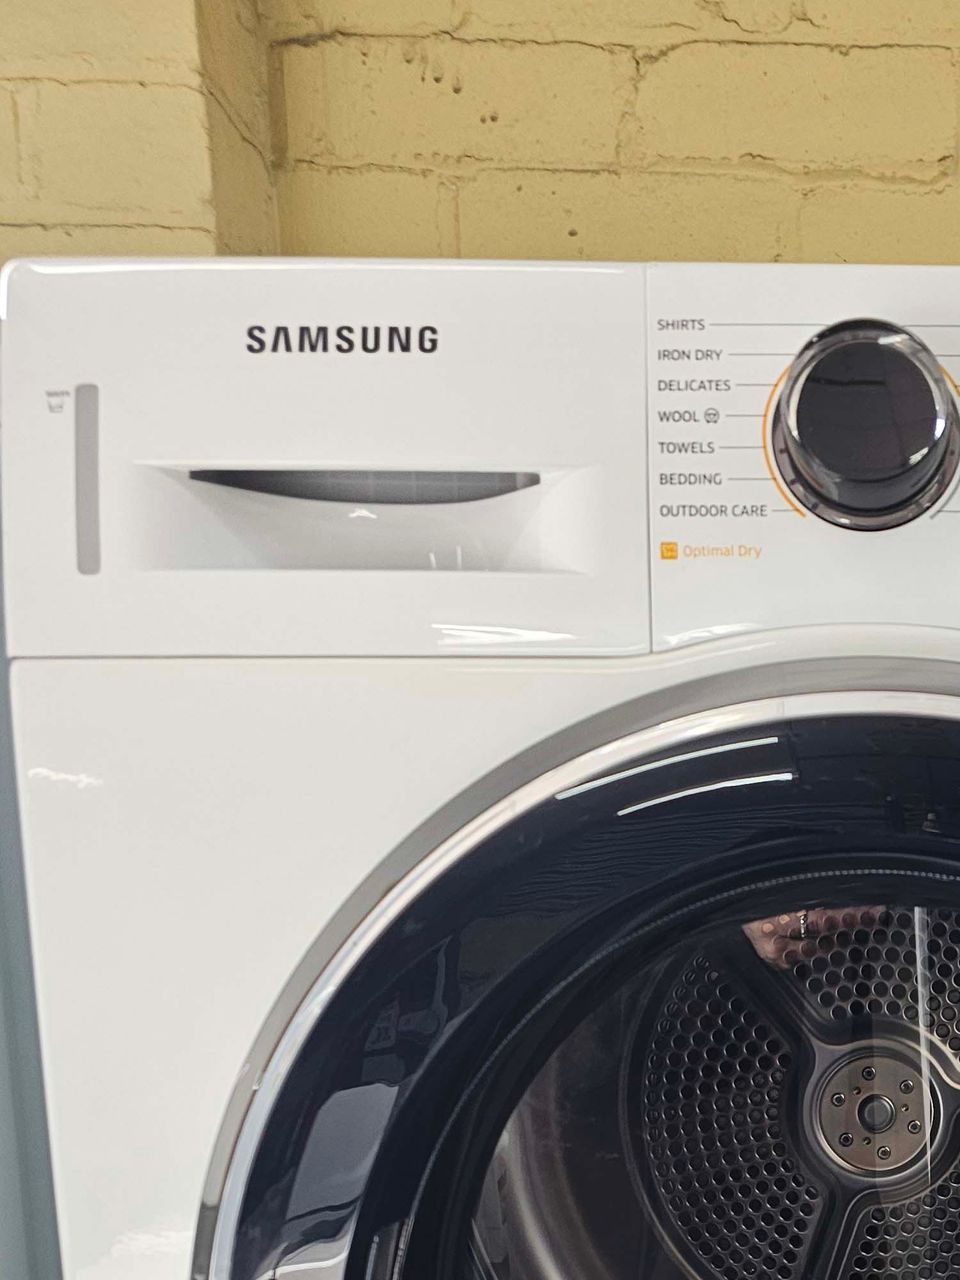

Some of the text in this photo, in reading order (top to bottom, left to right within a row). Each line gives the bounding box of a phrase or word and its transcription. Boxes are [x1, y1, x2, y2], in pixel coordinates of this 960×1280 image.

[657, 319, 706, 331] SHIRTS
[246, 325, 440, 354] SAMSUNG
[657, 349, 723, 361] IRON DRY
[657, 379, 731, 391] DELICATES
[658, 410, 699, 423] WOOL
[658, 442, 715, 454] TOWELS
[659, 473, 722, 485] BEDDING
[660, 504, 768, 518] OUTDOOR CARE
[683, 544, 762, 559] Optimal Dry
